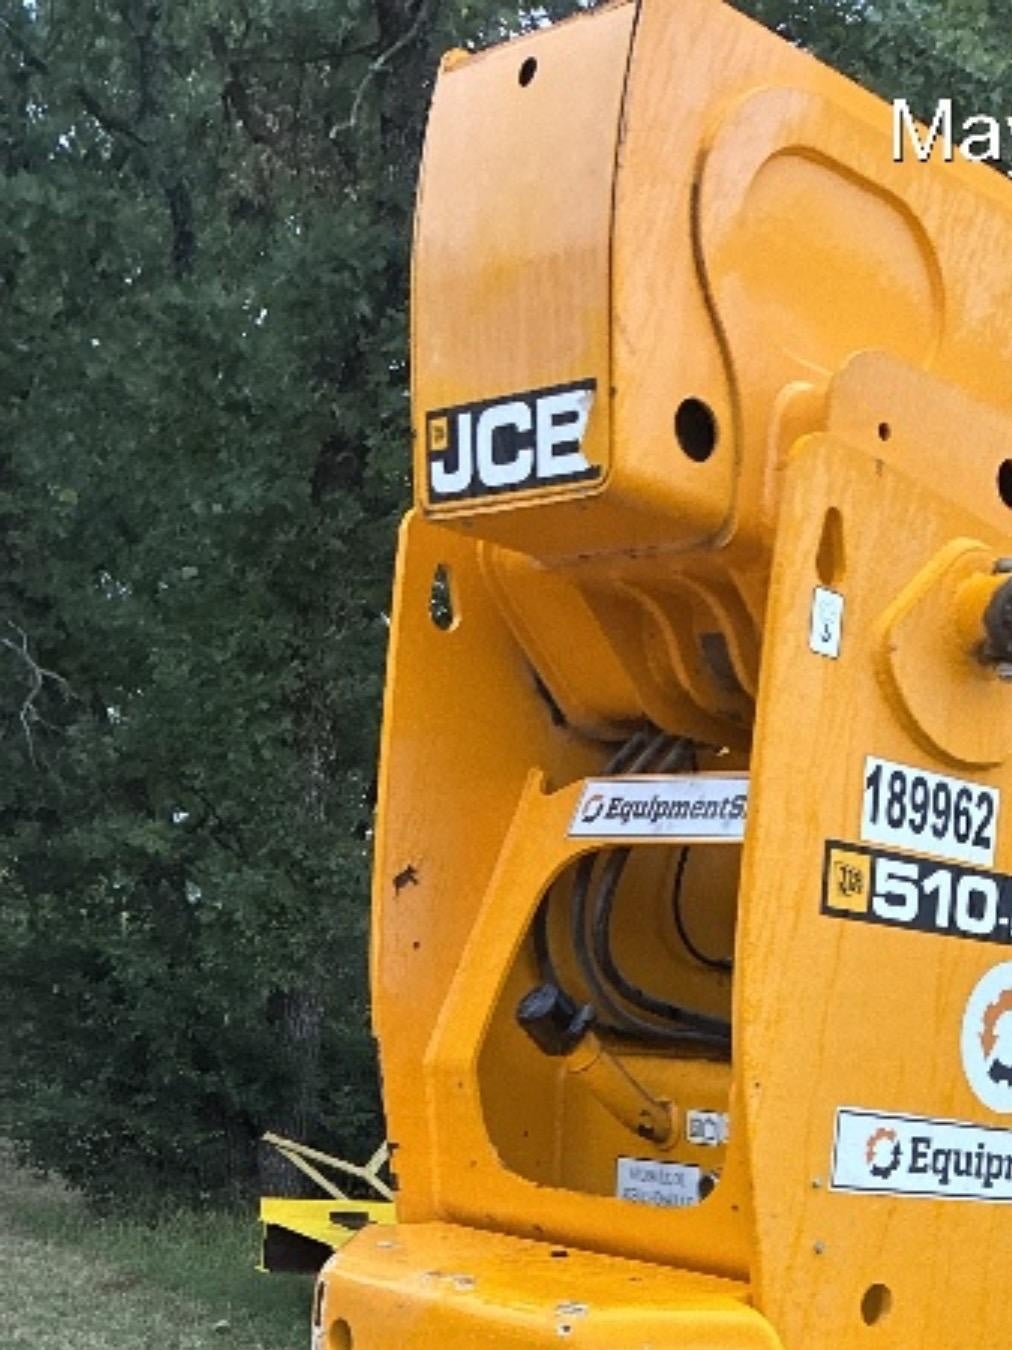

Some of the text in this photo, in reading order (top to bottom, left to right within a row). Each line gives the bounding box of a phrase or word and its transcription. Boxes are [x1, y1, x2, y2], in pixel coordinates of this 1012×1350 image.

[430, 389, 597, 493] JCB
[604, 794, 748, 824] EquipmentS
[866, 764, 995, 850] 189962
